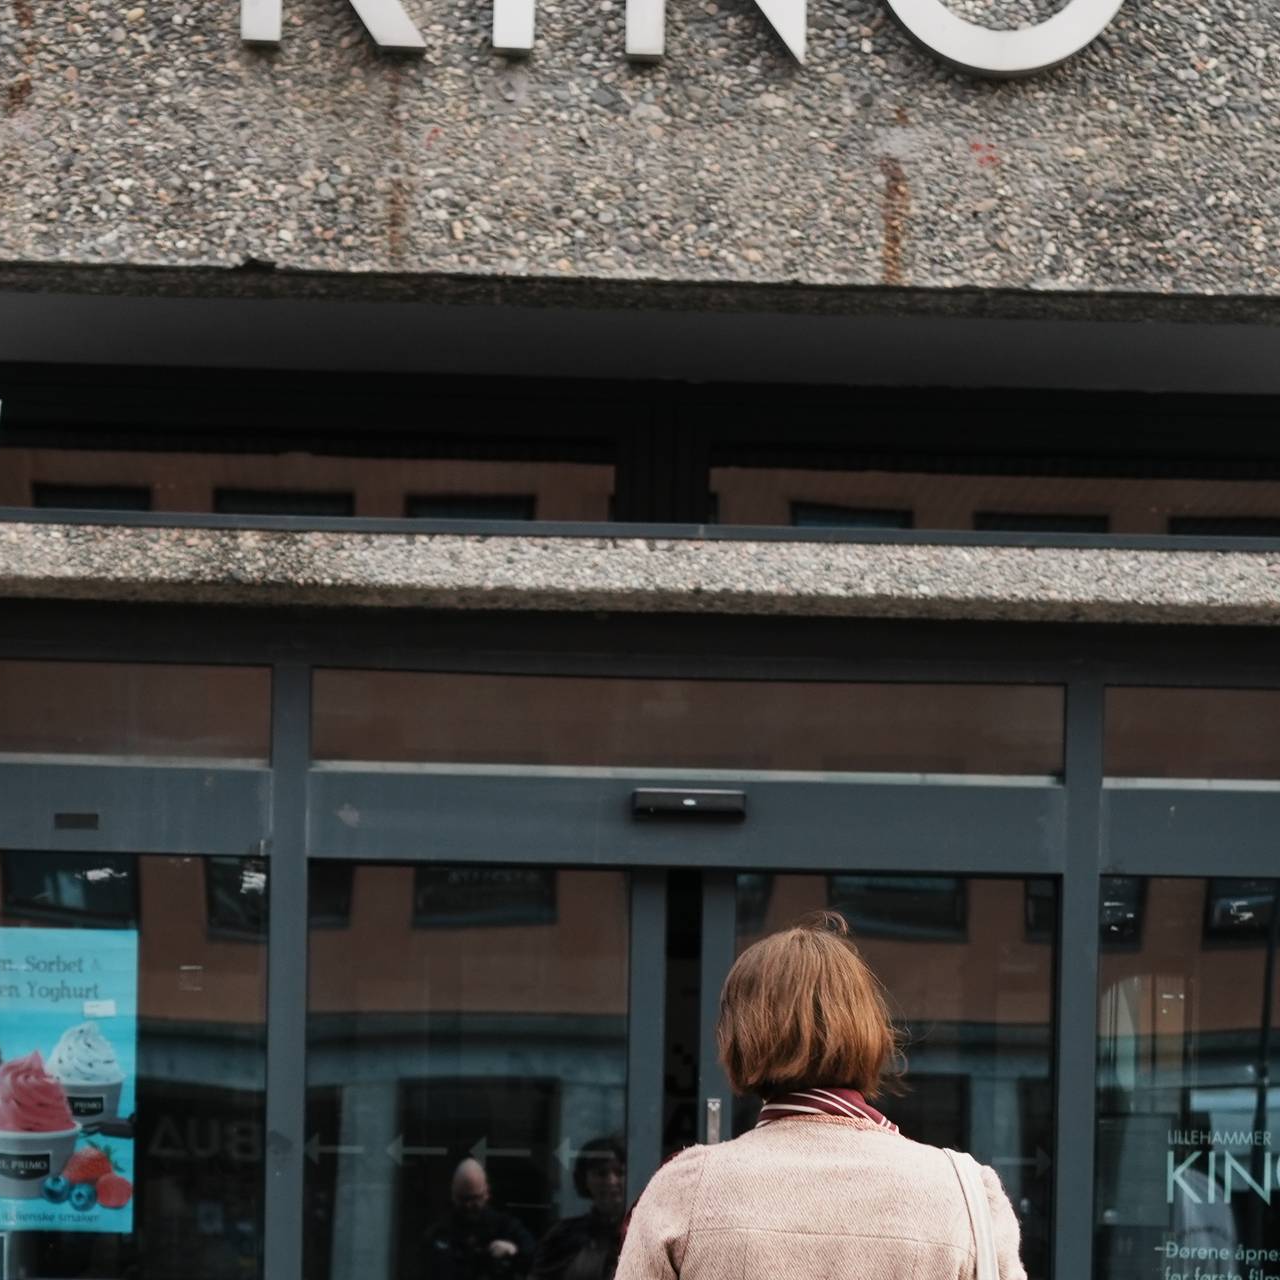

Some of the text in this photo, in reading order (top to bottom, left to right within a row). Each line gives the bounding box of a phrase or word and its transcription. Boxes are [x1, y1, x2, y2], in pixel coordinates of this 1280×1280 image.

[25, 955, 84, 973] Sorbet
[26, 980, 99, 1002] Yoghurt
[1167, 1130, 1272, 1146] LILLEHAMMER
[1165, 1242, 1230, 1260] Dørene
